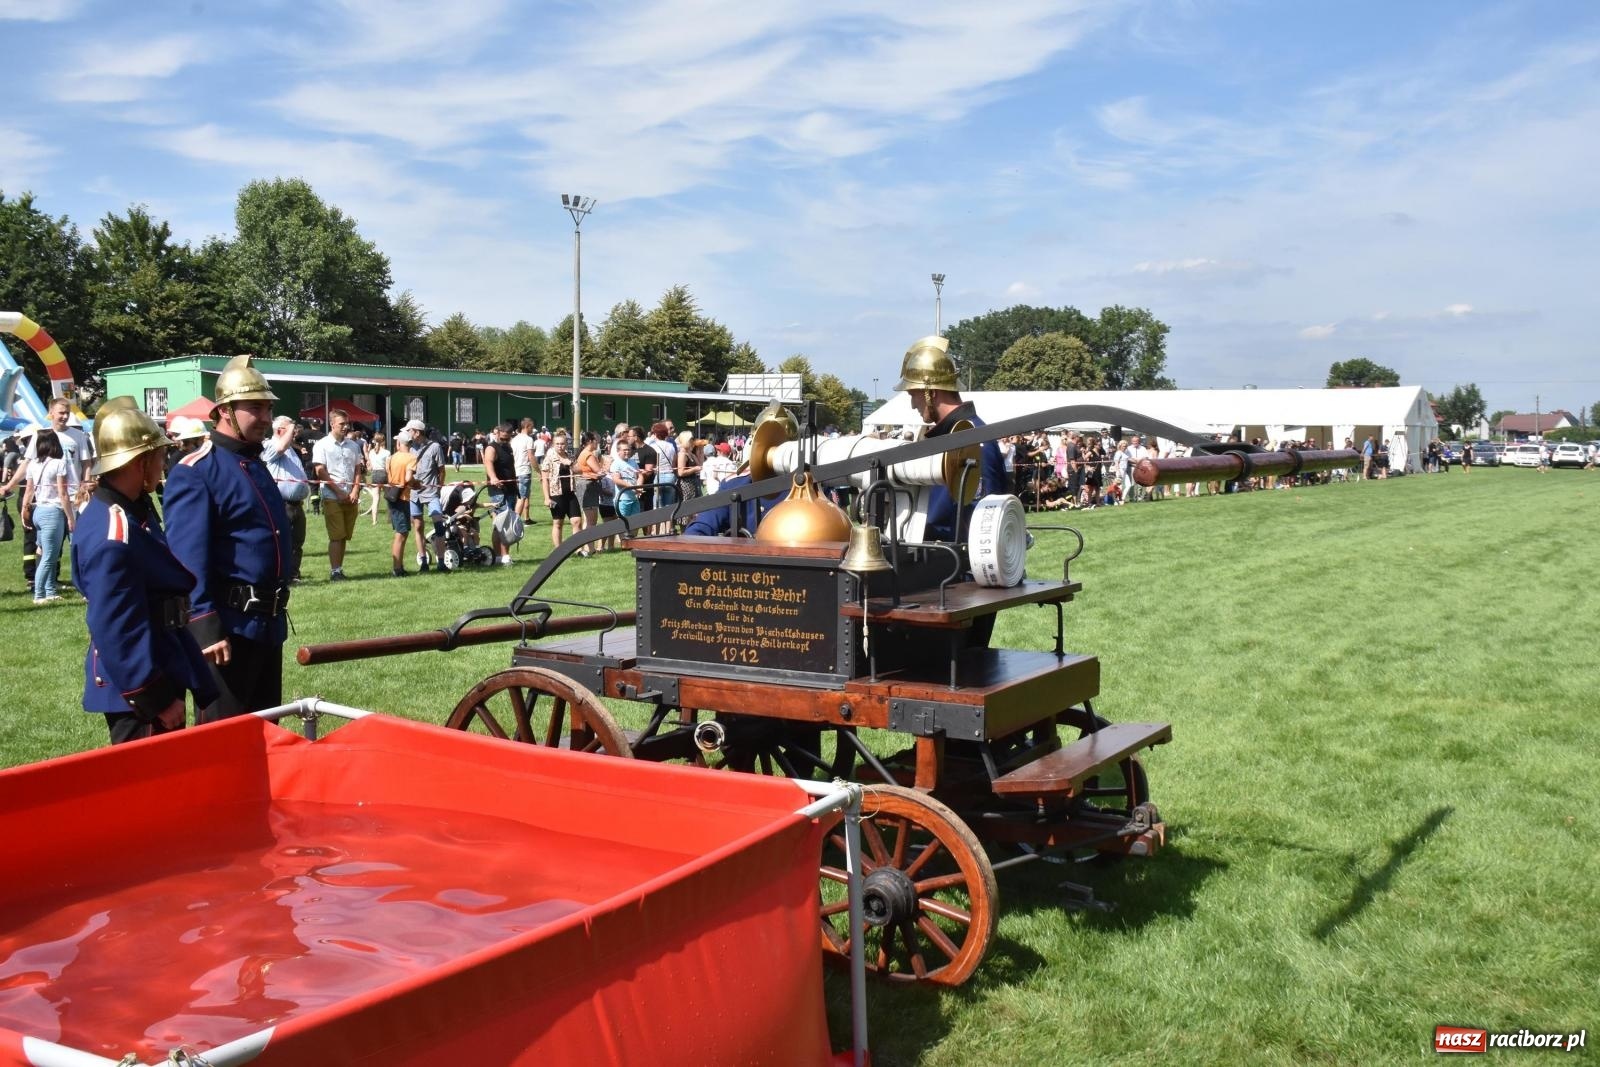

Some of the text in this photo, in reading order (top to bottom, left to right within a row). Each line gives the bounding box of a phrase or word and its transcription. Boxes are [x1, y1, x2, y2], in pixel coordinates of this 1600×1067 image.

[701, 568, 727, 581] Gott
[731, 573, 750, 584] zur
[678, 582, 807, 603] Dem Nächsten zur Wehr!
[686, 599, 798, 616] Ein Geschenk des Gutsherrn
[661, 619, 681, 628] Fritz
[716, 623, 740, 633] Baron
[742, 625, 753, 633] von
[726, 613, 755, 623] für die
[672, 630, 810, 653] Freiwillige Feuerwehr Silberkopf
[721, 647, 759, 664] 1912
